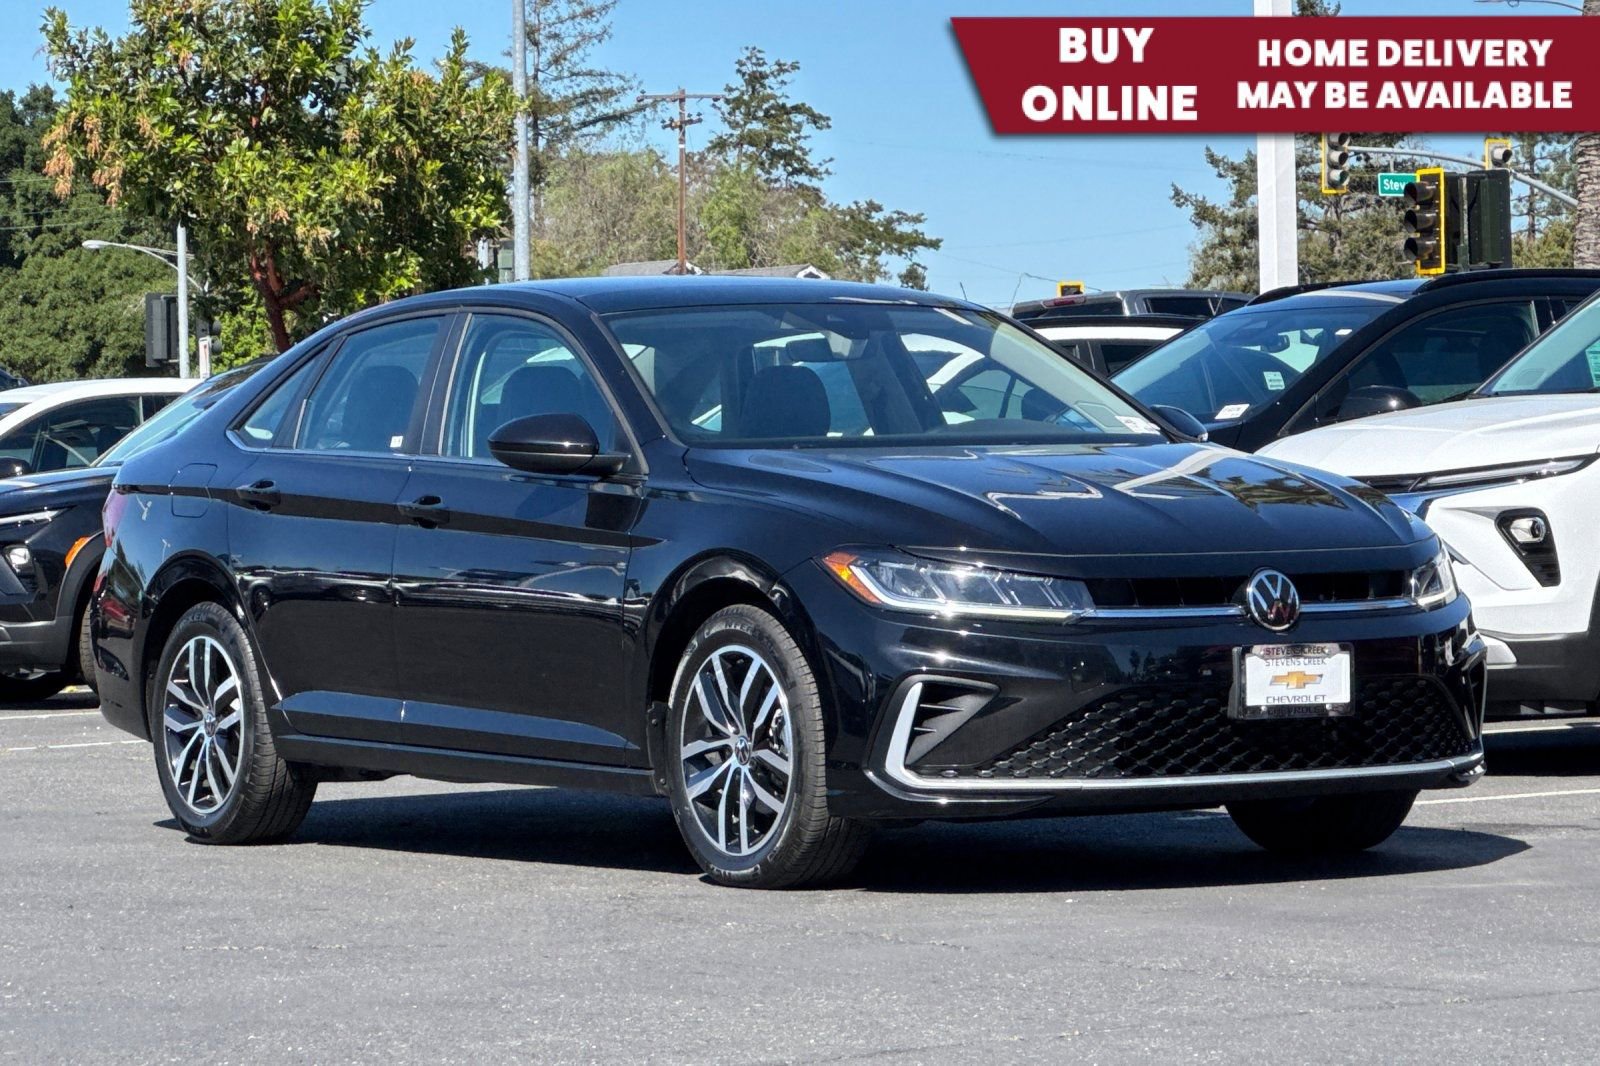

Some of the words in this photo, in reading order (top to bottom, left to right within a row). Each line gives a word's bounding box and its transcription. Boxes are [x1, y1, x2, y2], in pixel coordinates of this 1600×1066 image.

[1265, 646, 1300, 656] STEVENS
[1303, 645, 1327, 655] CREEK
[1265, 658, 1300, 667] STEVENS
[1303, 657, 1327, 666] CREEK
[1266, 694, 1327, 704] CHEVROLET
